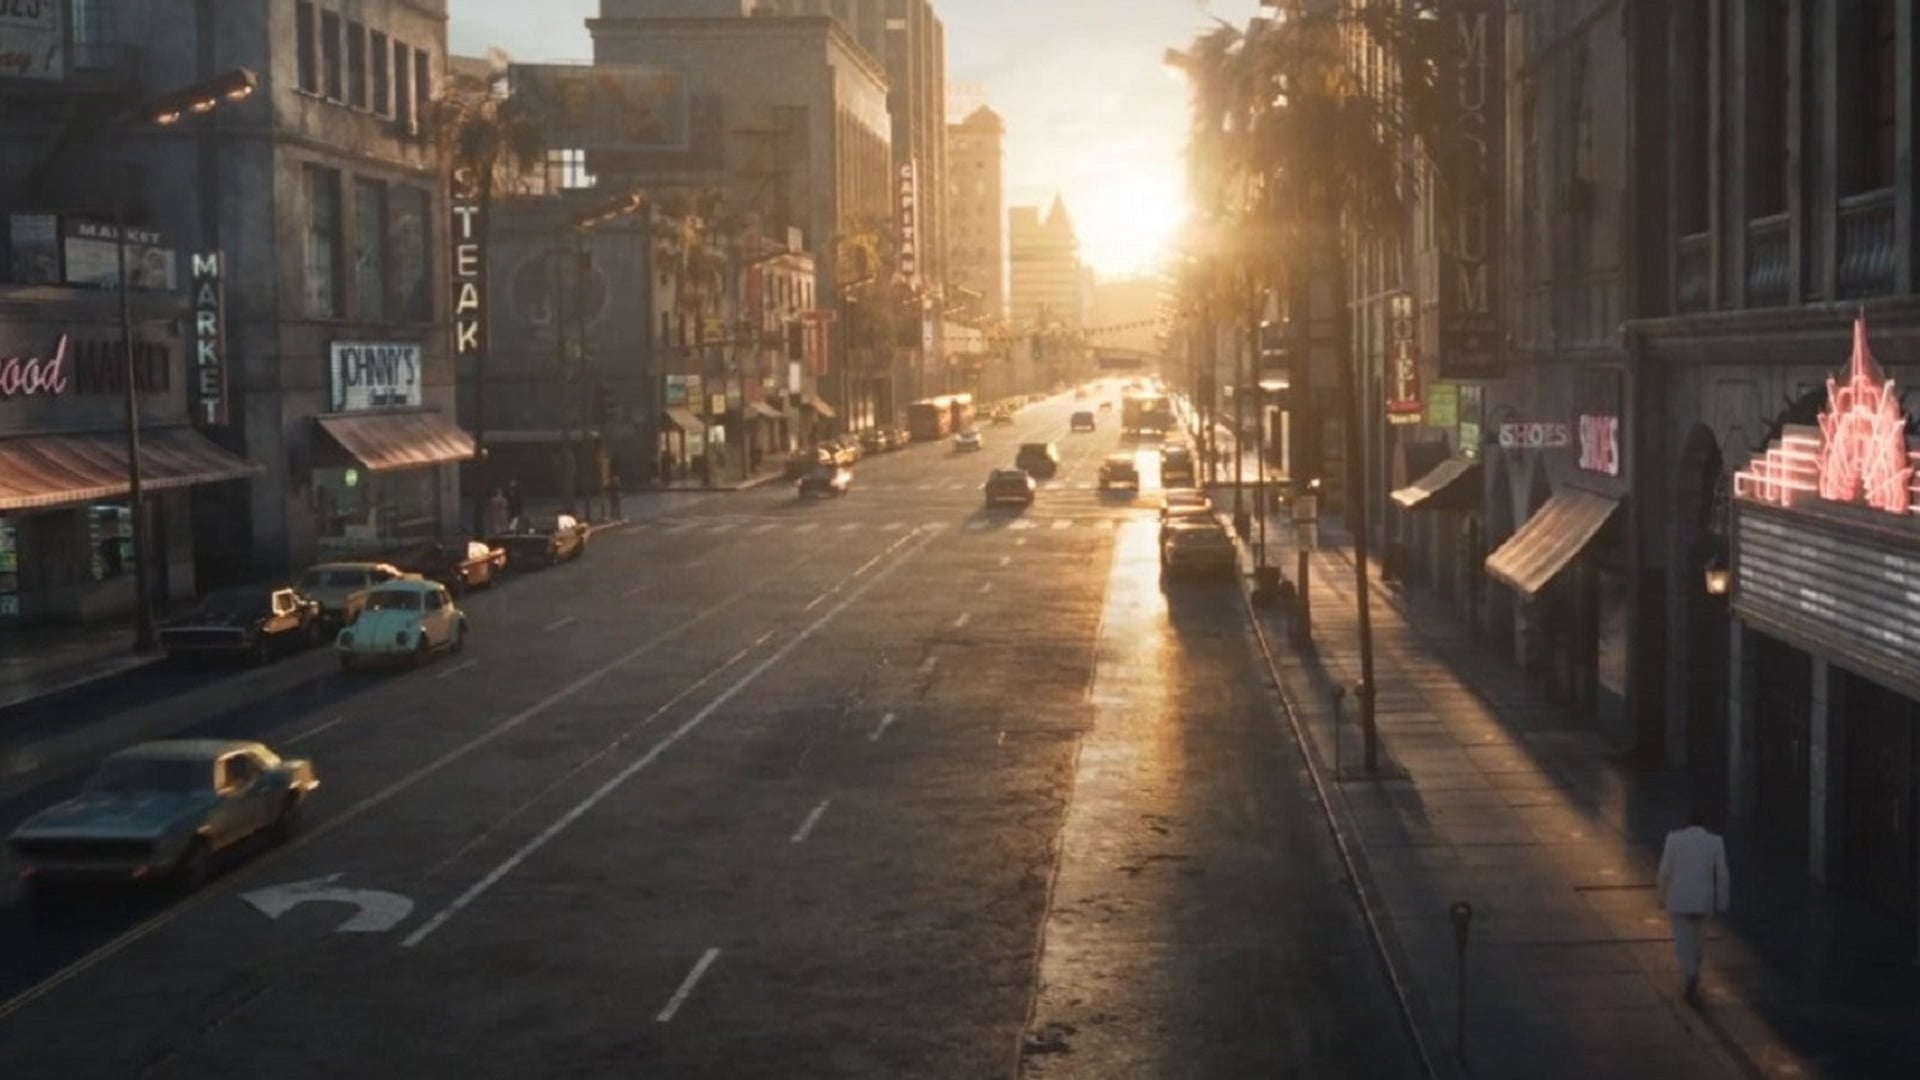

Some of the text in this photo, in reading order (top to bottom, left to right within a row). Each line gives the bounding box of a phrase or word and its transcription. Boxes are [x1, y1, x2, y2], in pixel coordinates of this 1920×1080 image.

[1456, 12, 1488, 313] MUSUM
[453, 167, 480, 355] STEAK
[0, 333, 68, 395] ood
[191, 253, 220, 424] MARKET
[337, 347, 414, 412] JOHNNY'S
[1498, 423, 1567, 448] SHOES
